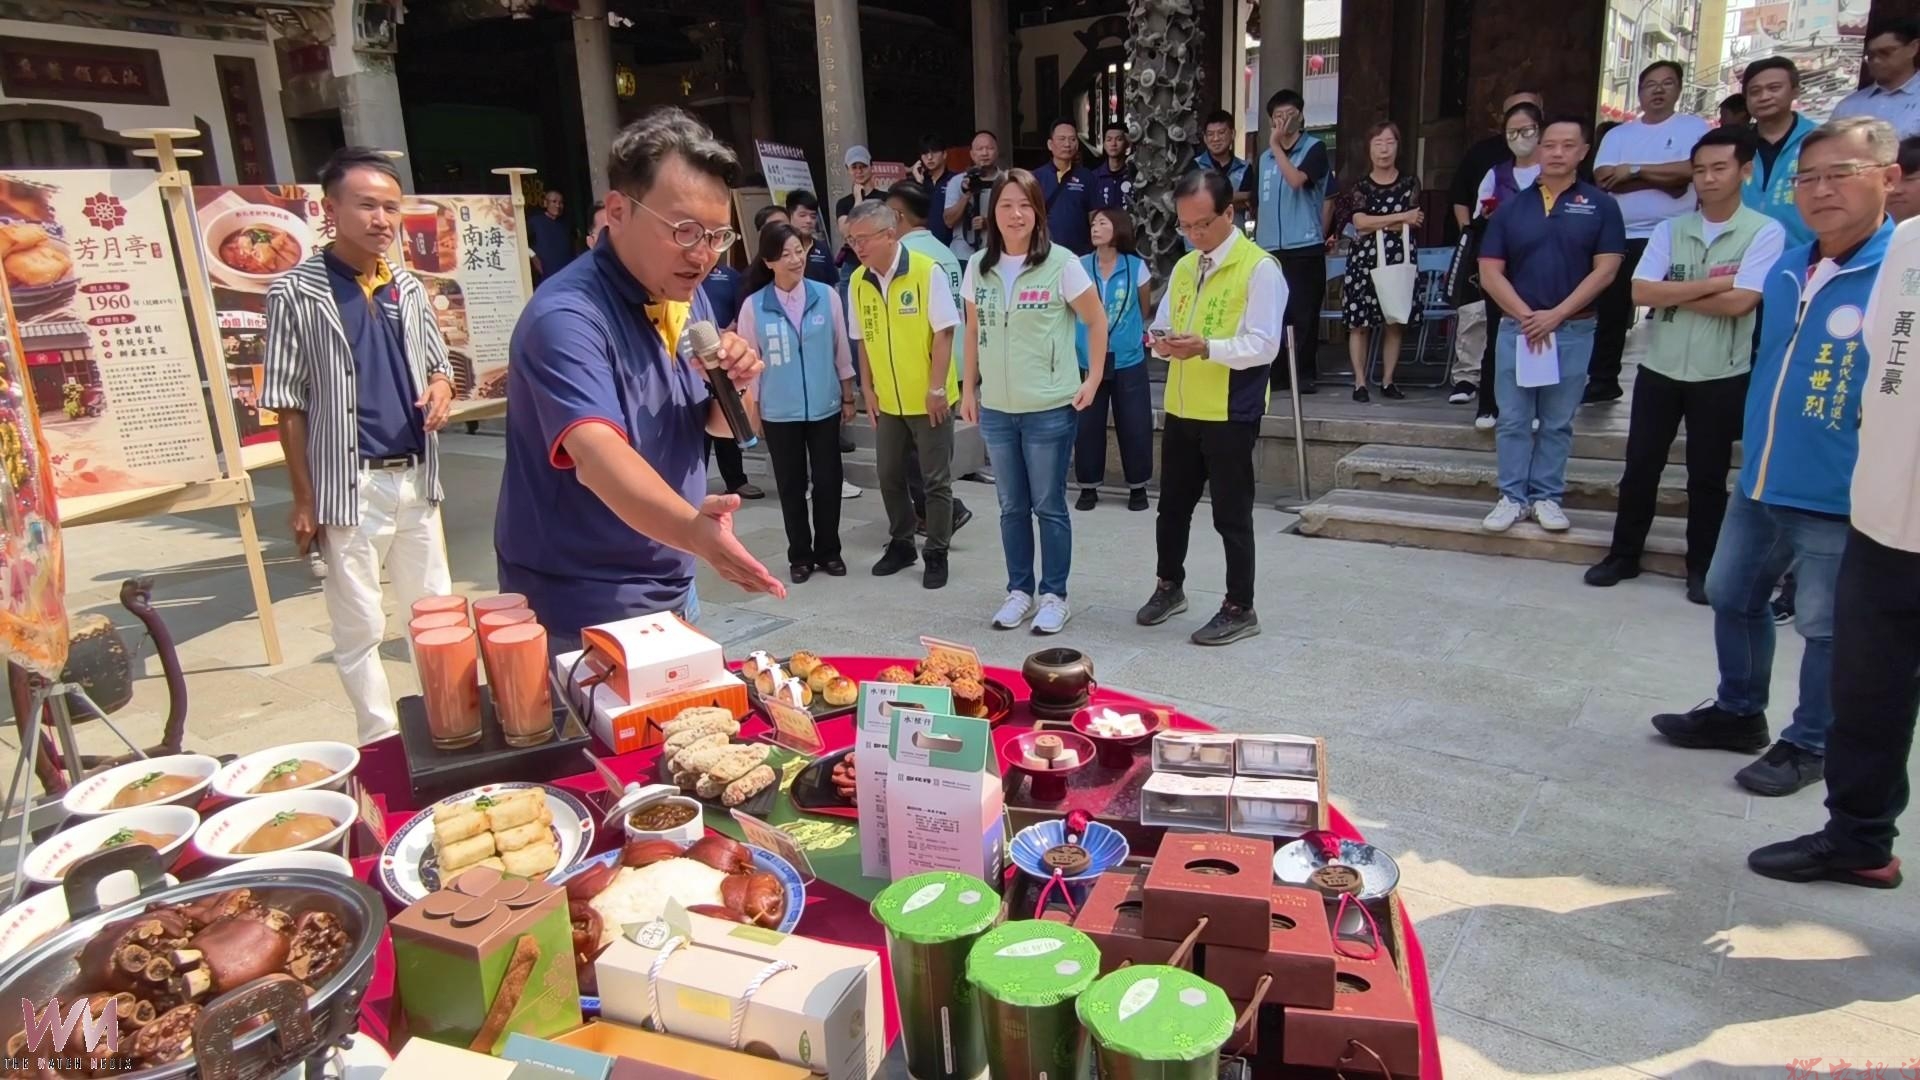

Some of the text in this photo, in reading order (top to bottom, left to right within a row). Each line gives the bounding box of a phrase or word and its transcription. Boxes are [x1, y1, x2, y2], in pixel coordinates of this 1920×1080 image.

[73, 234, 148, 261] 芳月亭
[462, 223, 505, 248] 南海
[463, 247, 507, 272] 茶道
[86, 293, 131, 311] 1960
[1879, 310, 1916, 396] 黃正豪
[1801, 343, 1834, 420] 王世烈
